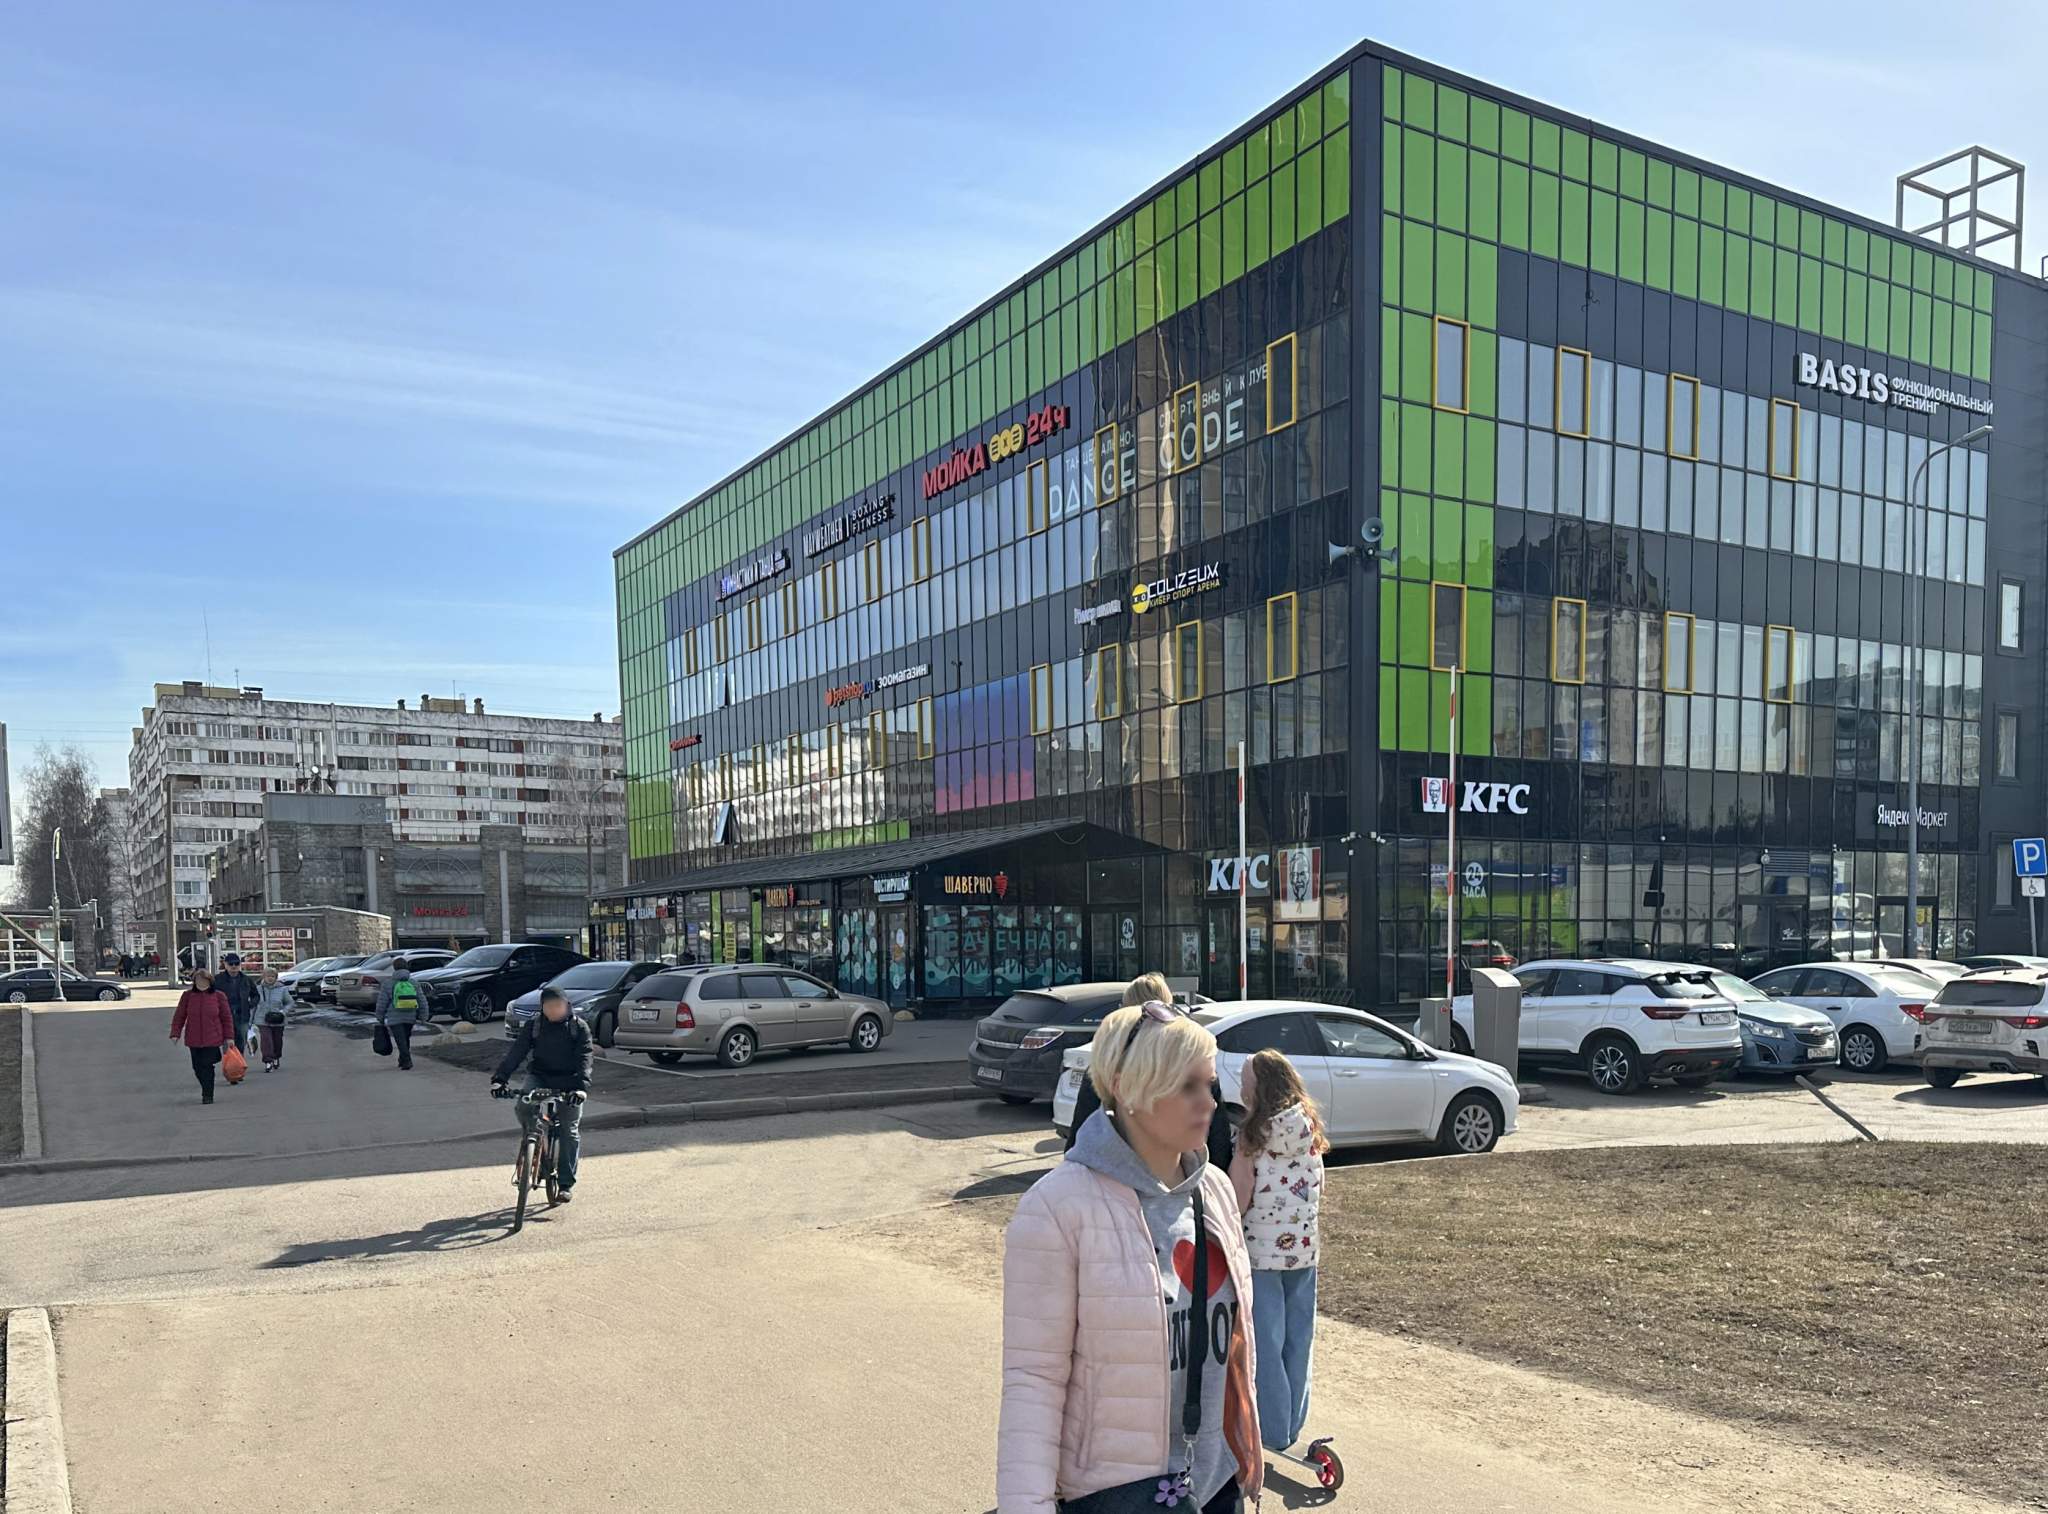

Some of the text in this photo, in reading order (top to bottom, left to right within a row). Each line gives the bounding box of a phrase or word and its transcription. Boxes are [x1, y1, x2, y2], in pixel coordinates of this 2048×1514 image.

[1800, 352, 1889, 403] BASIS
[1891, 391, 1940, 415] ТРЕНИНГ
[1892, 376, 1993, 415] ФУНКЦИОНАЛЬНЫЙ
[922, 442, 985, 499] МОЙКА
[852, 508, 888, 533] FITNESS
[1172, 586, 1195, 601] СПОРТ
[1196, 578, 1220, 593] АРЕНА
[878, 664, 927, 688] зоомагазин
[1460, 781, 1530, 815] KFC
[2022, 843, 2040, 872] P
[944, 876, 993, 894] ШАВЕРНО
[1468, 867, 1484, 883] 24
[1462, 886, 1487, 898] ЧАСА
